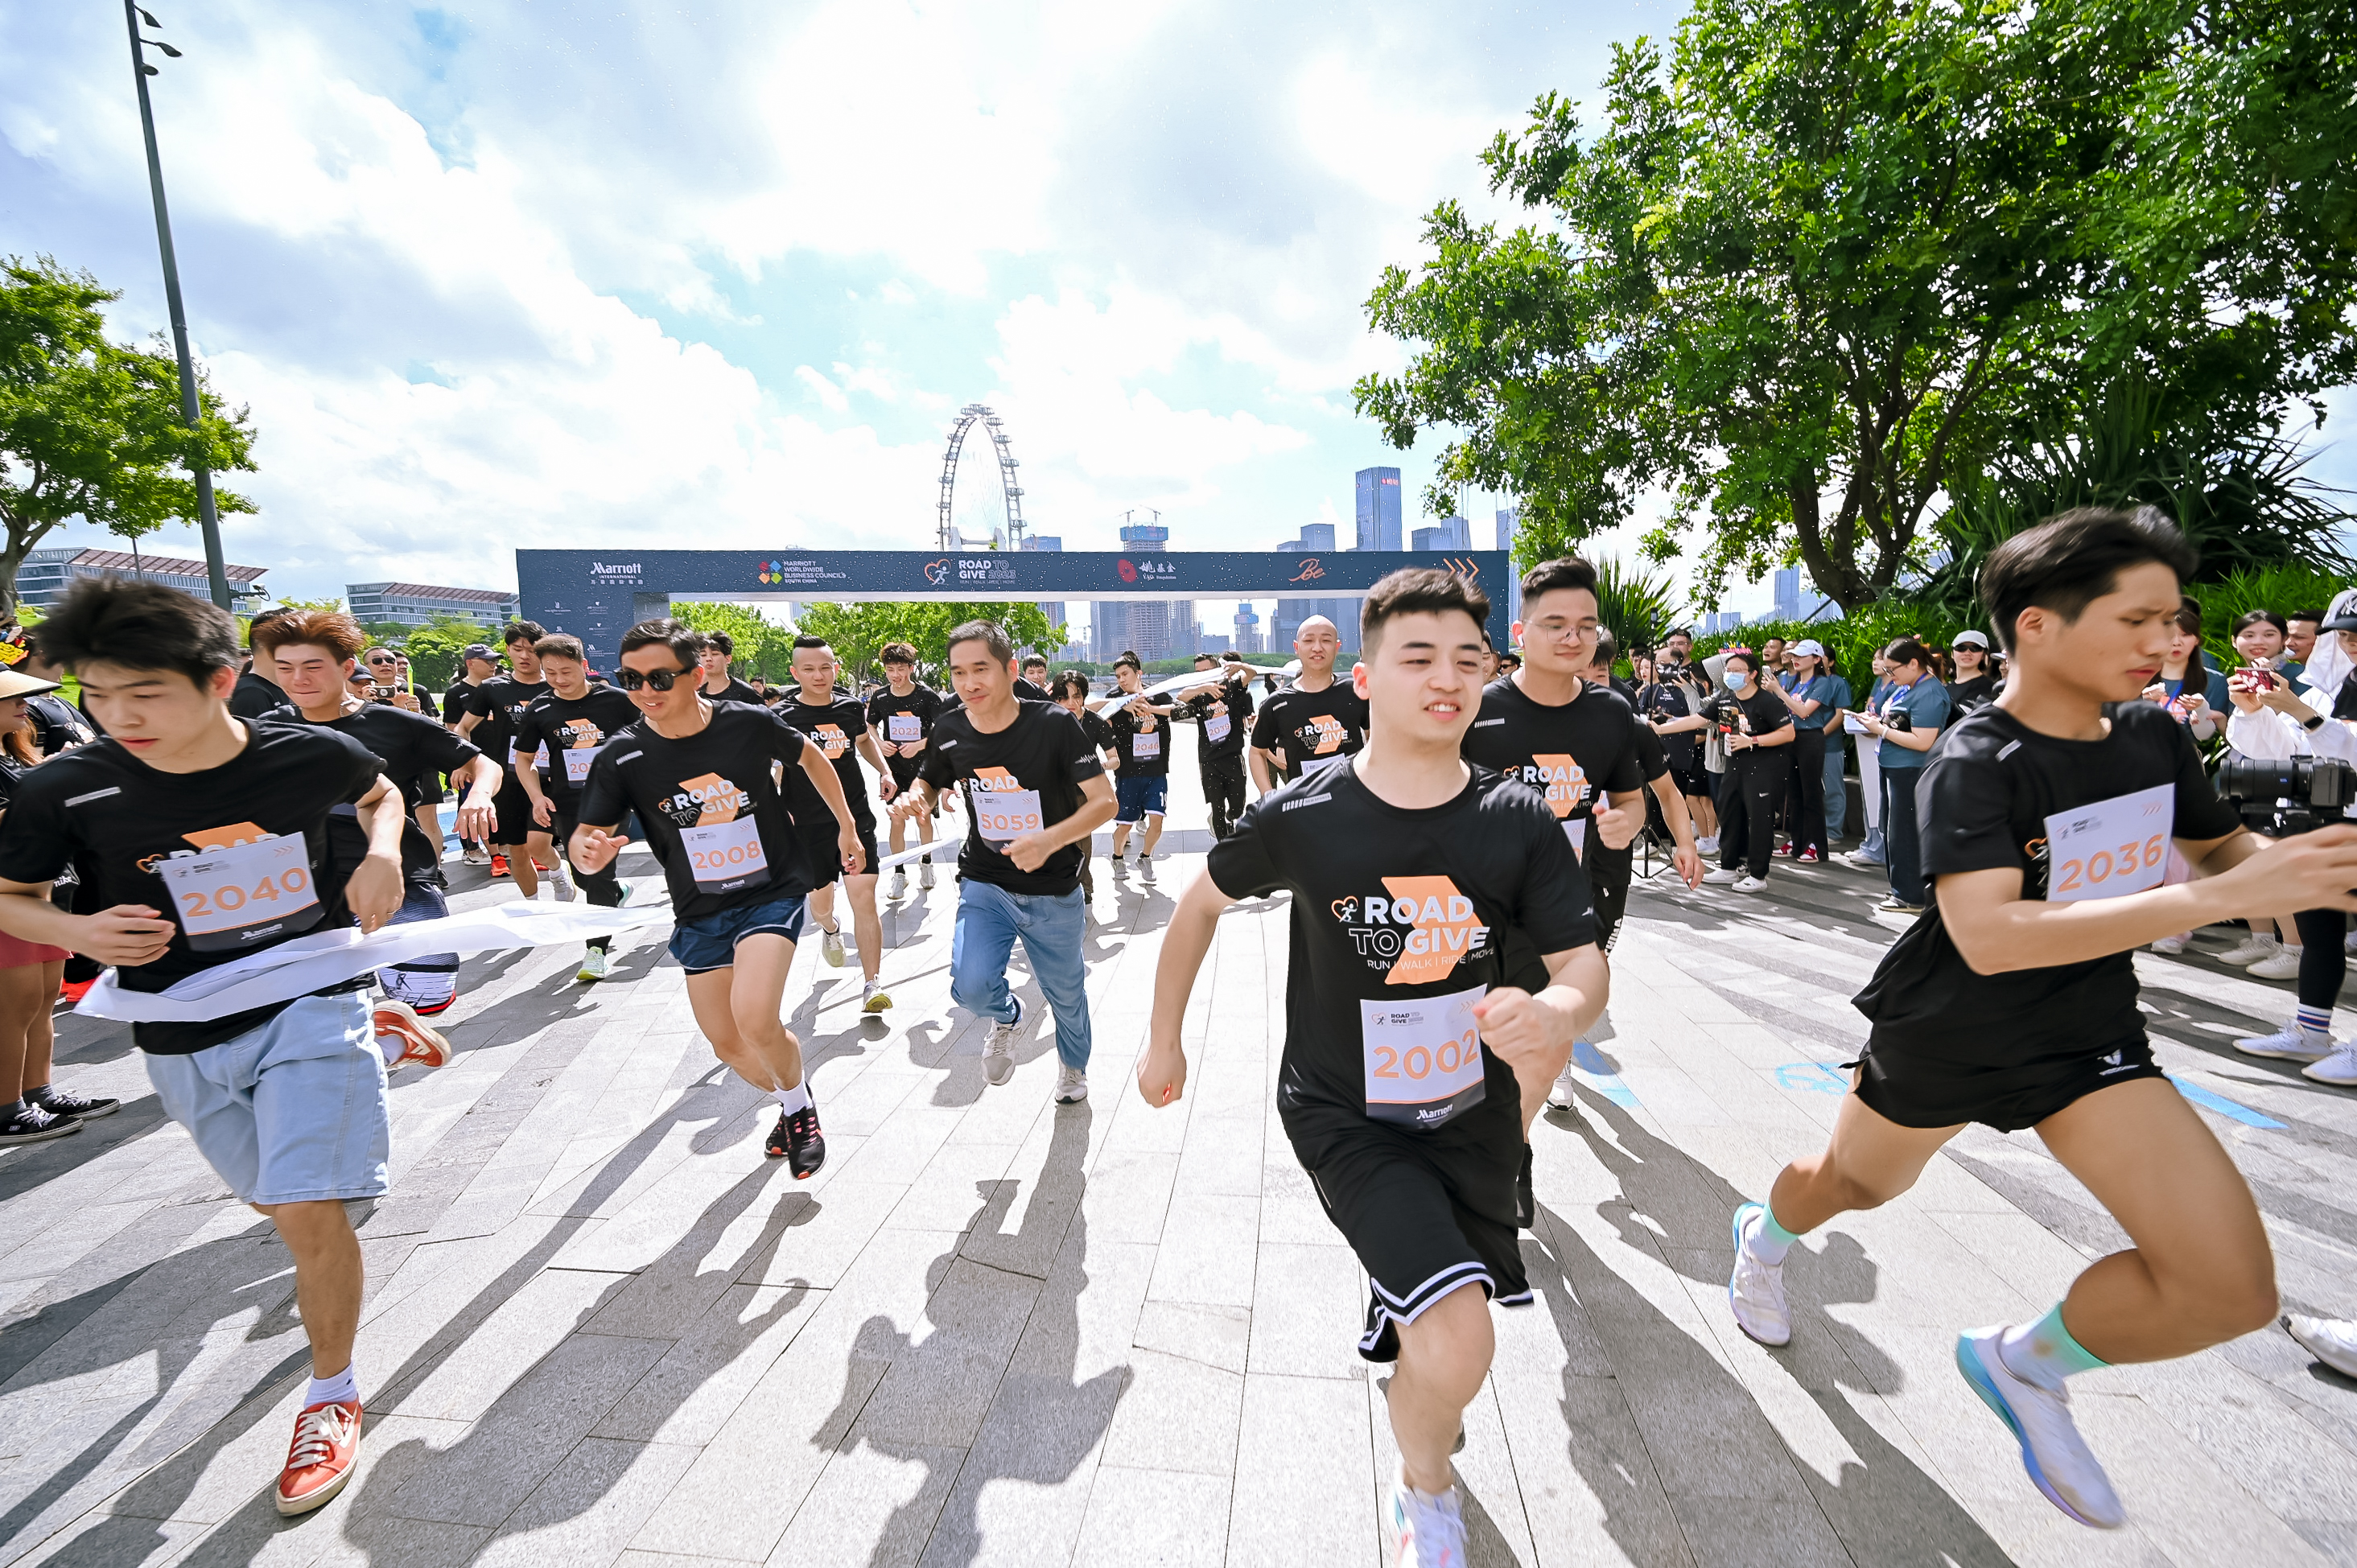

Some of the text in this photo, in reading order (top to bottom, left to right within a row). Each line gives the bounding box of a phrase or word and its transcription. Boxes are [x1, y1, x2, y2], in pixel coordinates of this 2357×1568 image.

[590, 562, 641, 574] Marriott
[958, 560, 1009, 570] ROAD TO
[1288, 558, 1326, 582] Be
[959, 570, 986, 579] GIVE
[1134, 714, 1155, 722] ROAD
[561, 723, 597, 736] ROAD
[577, 730, 605, 741] GIVE
[810, 730, 846, 740] ROAD
[892, 727, 919, 735] 2022
[1304, 720, 1341, 735] ROAD
[824, 739, 851, 750] GIVE
[1301, 735, 1319, 746] TO
[1320, 730, 1348, 743] GIVE
[1523, 766, 1584, 783] ROAD
[969, 775, 1019, 792] ROAD
[673, 780, 735, 810] ROAD
[1544, 784, 1592, 800] GIVE
[670, 807, 700, 826] TO
[701, 791, 750, 813] GIVE
[980, 813, 1039, 831] 5059
[692, 841, 760, 869] 2008
[2057, 833, 2164, 893] 2036
[181, 868, 307, 917] 2040
[1365, 896, 1473, 924] ROAD
[1349, 927, 1490, 957] TO GIVE
[1367, 946, 1495, 969] RUN WALK RIDE MOVE
[1373, 1029, 1478, 1080] 2002
[1416, 1104, 1453, 1120] Marriott
